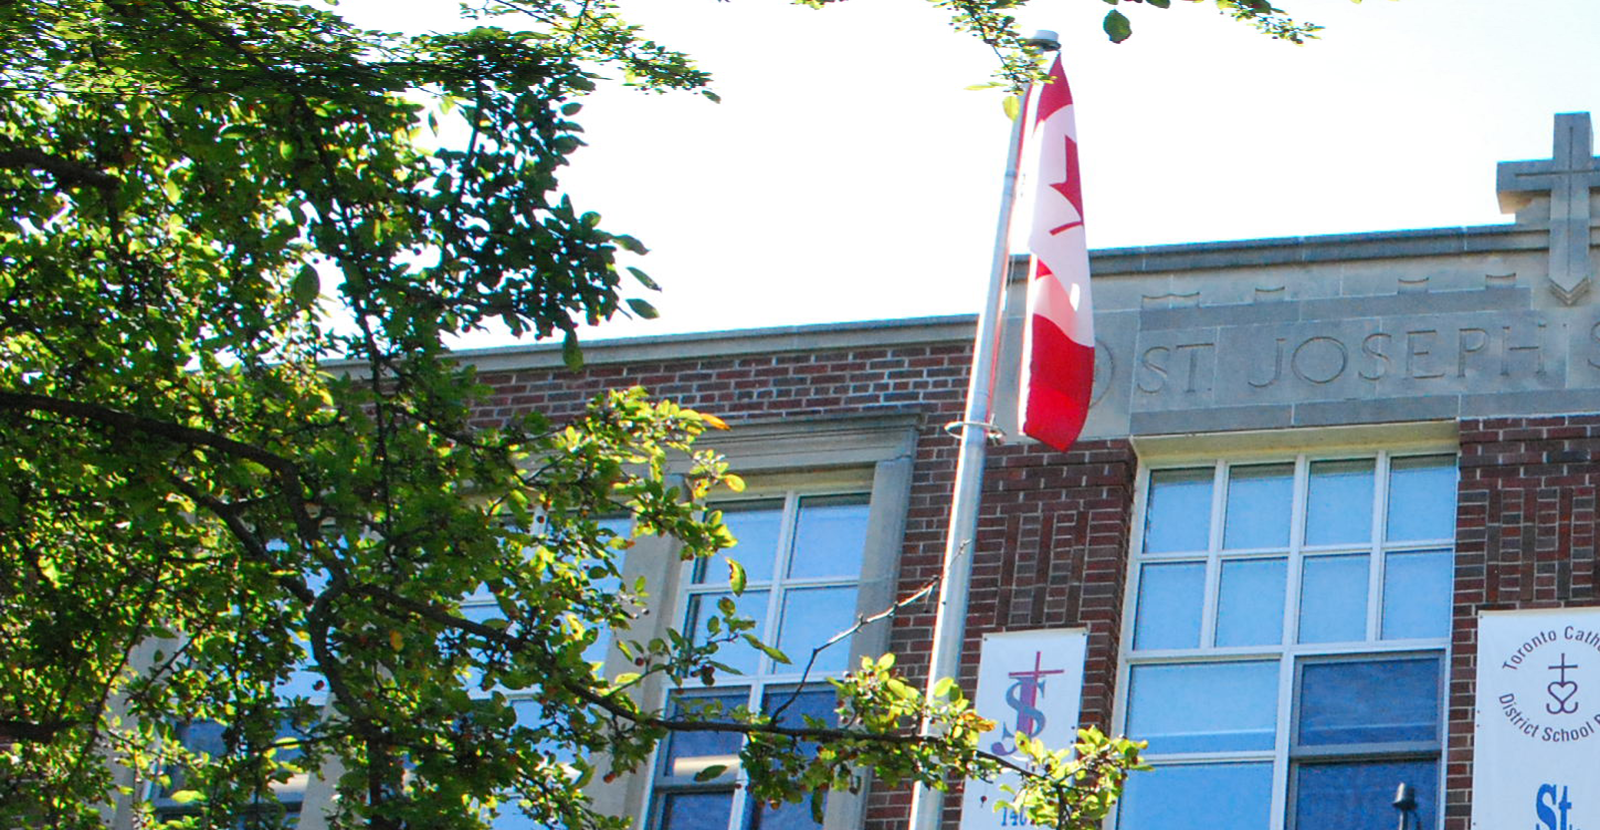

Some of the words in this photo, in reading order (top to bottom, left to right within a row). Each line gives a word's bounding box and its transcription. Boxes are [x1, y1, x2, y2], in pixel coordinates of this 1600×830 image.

[1137, 342, 1215, 394] ST.
[1502, 629, 1557, 671] Toronto
[1499, 692, 1540, 738] District
[1541, 721, 1595, 743] School
[1536, 783, 1574, 830] St
